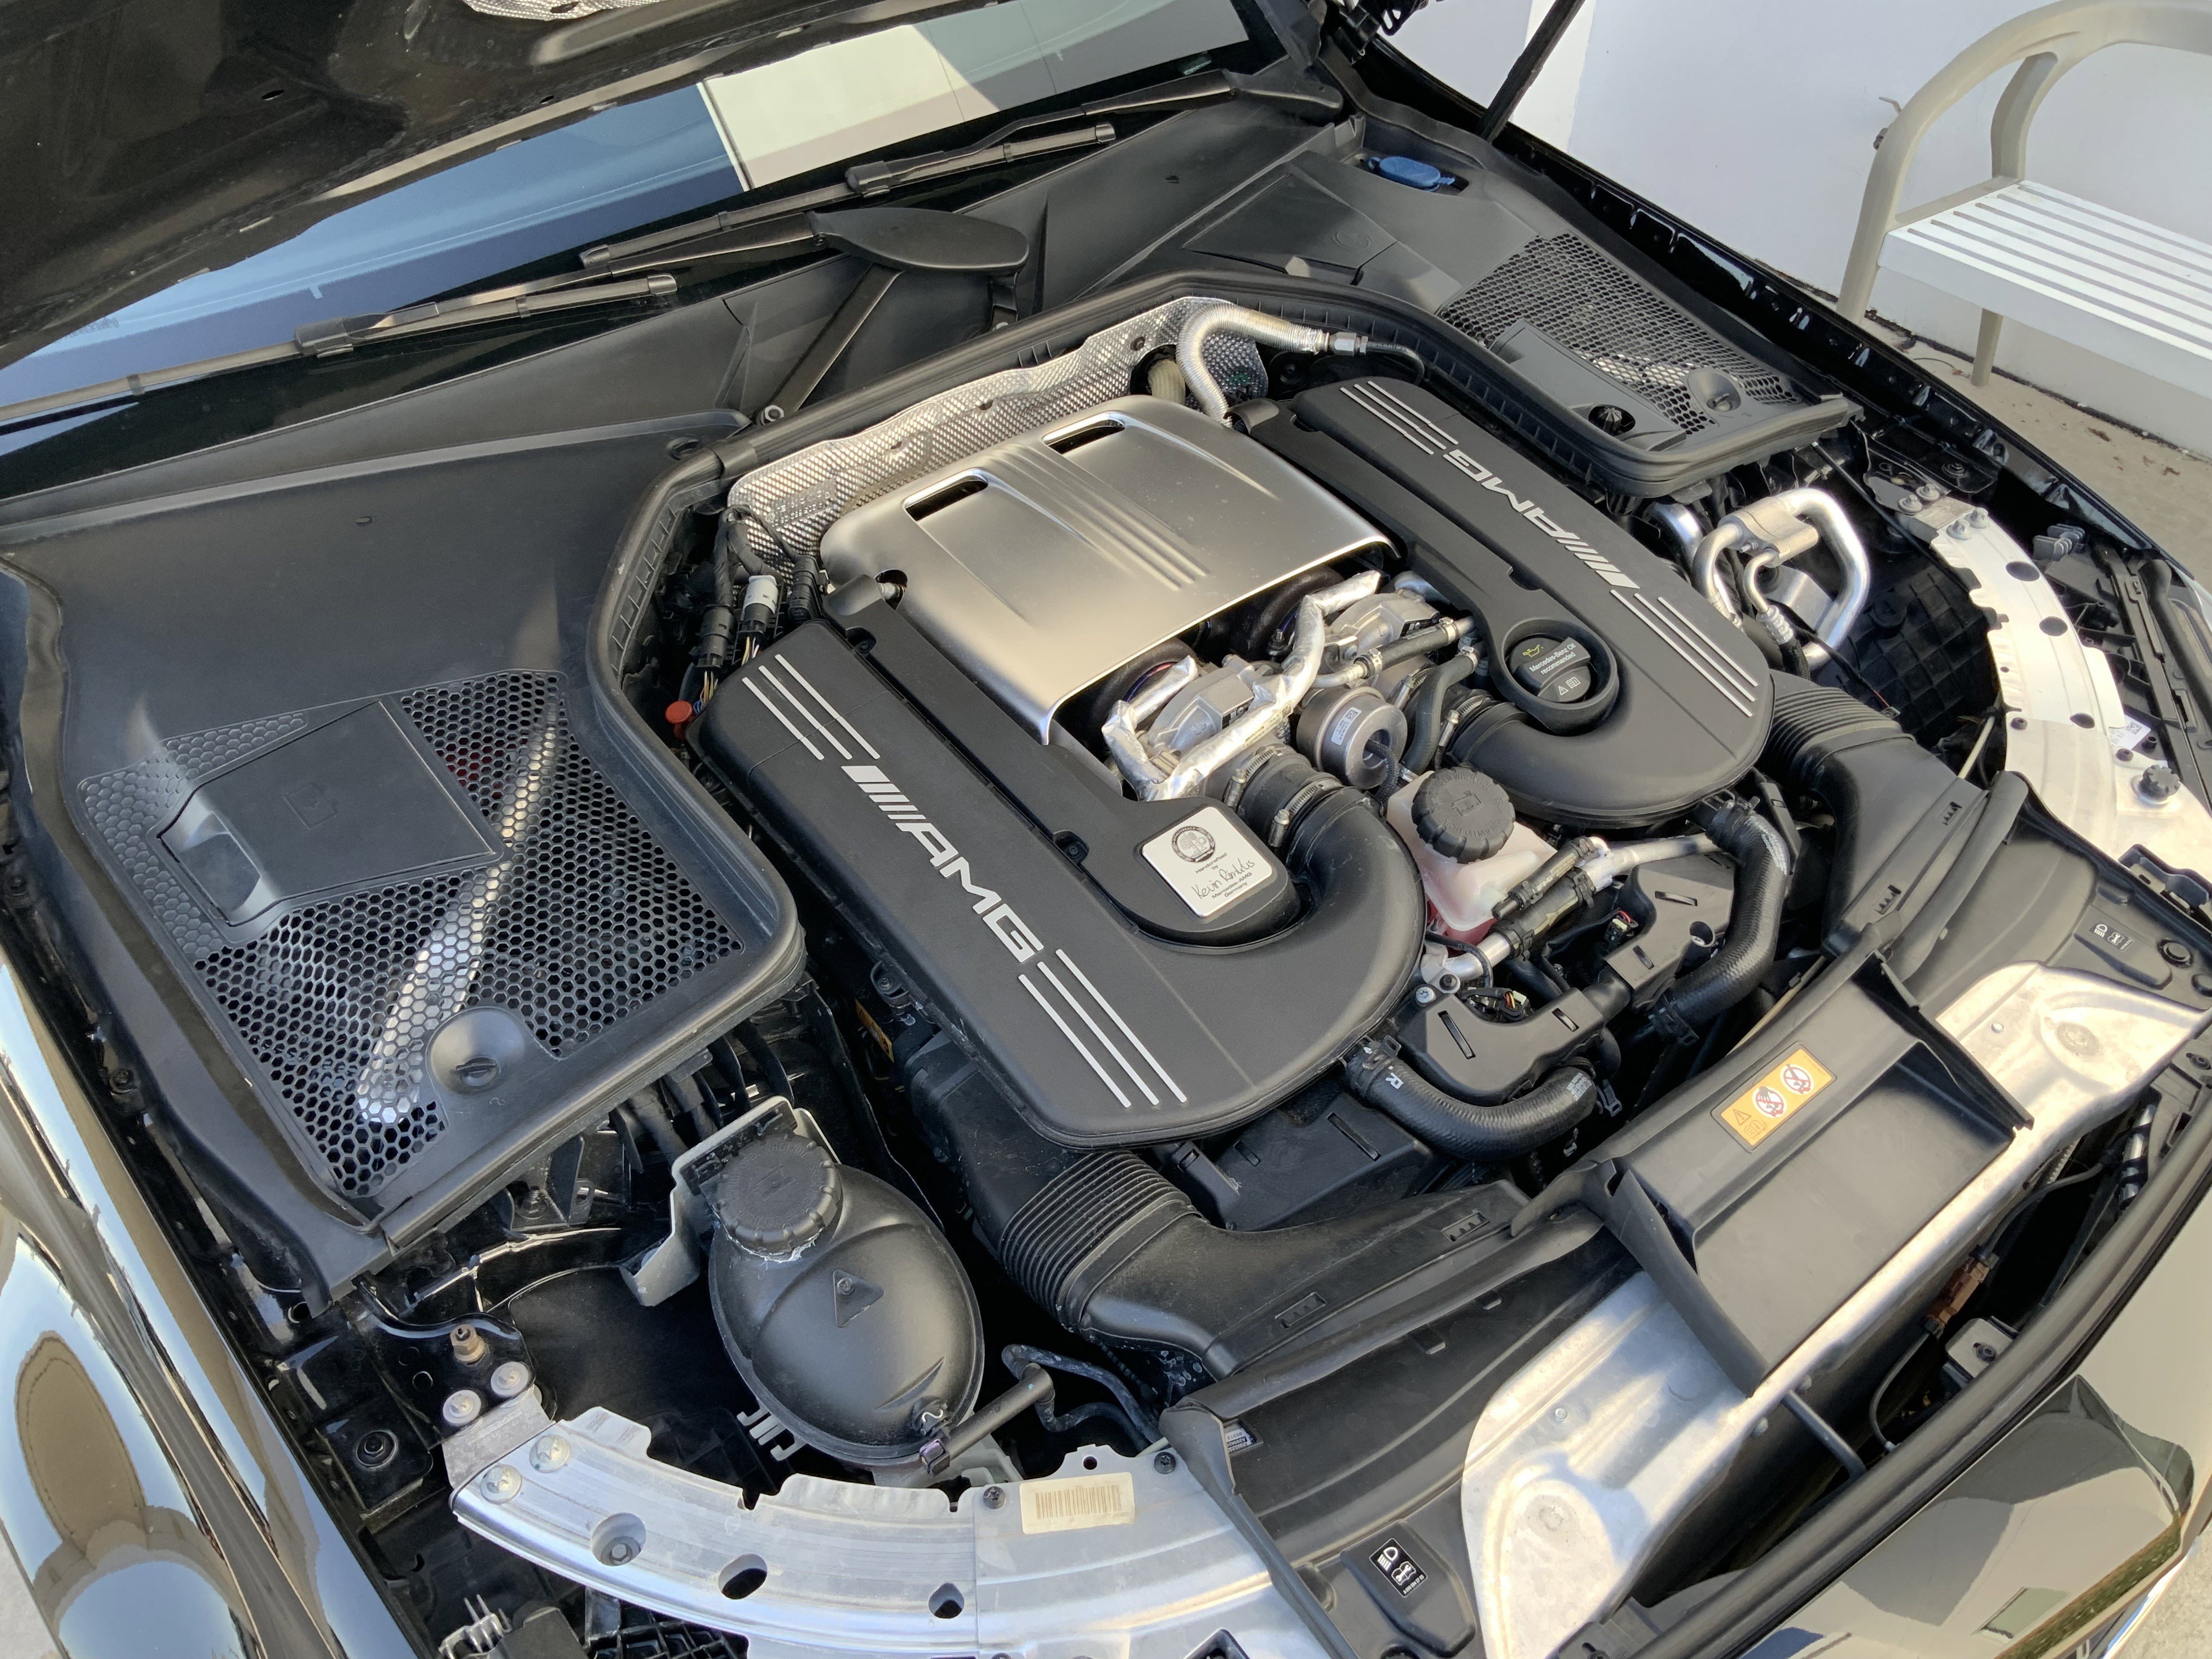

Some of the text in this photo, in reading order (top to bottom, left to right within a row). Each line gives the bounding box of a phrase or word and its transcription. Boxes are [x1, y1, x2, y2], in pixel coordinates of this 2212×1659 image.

[1529, 642, 1577, 672] Mercedes-Benz Oil
[1541, 652, 1576, 674] recommended
[1195, 852, 1228, 874] Handcrafted
[1191, 879, 1222, 900] Kevin
[1211, 872, 1252, 900] Mercedes-AMG
[1224, 881, 1248, 898] Germany
